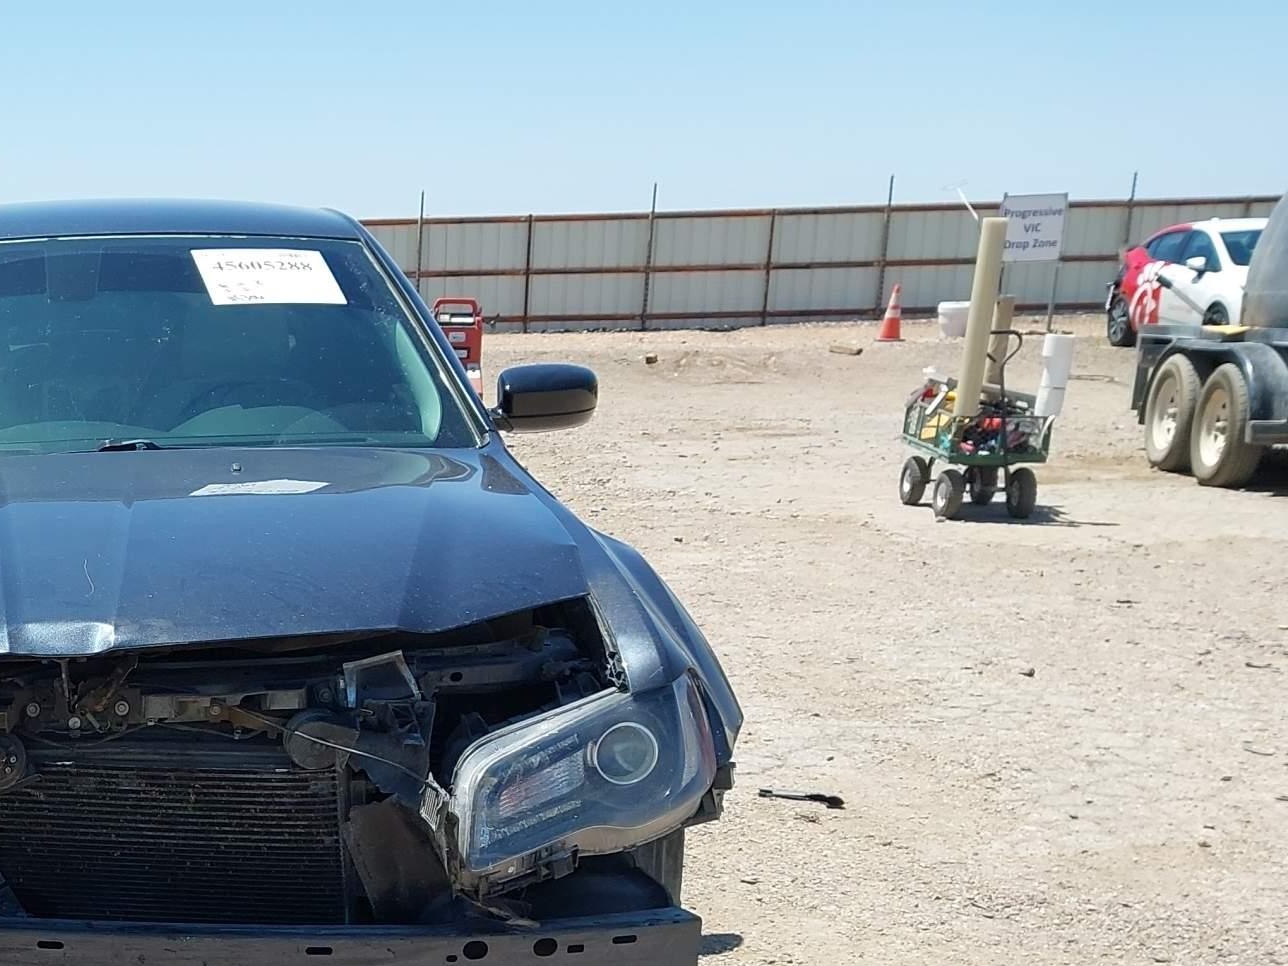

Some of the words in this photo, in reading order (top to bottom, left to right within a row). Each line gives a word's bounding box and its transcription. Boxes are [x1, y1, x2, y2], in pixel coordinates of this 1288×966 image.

[1003, 208, 1064, 219] Progressive
[1023, 223, 1041, 233] VIC
[1004, 239, 1030, 251] Drop
[1032, 239, 1058, 248] Zone
